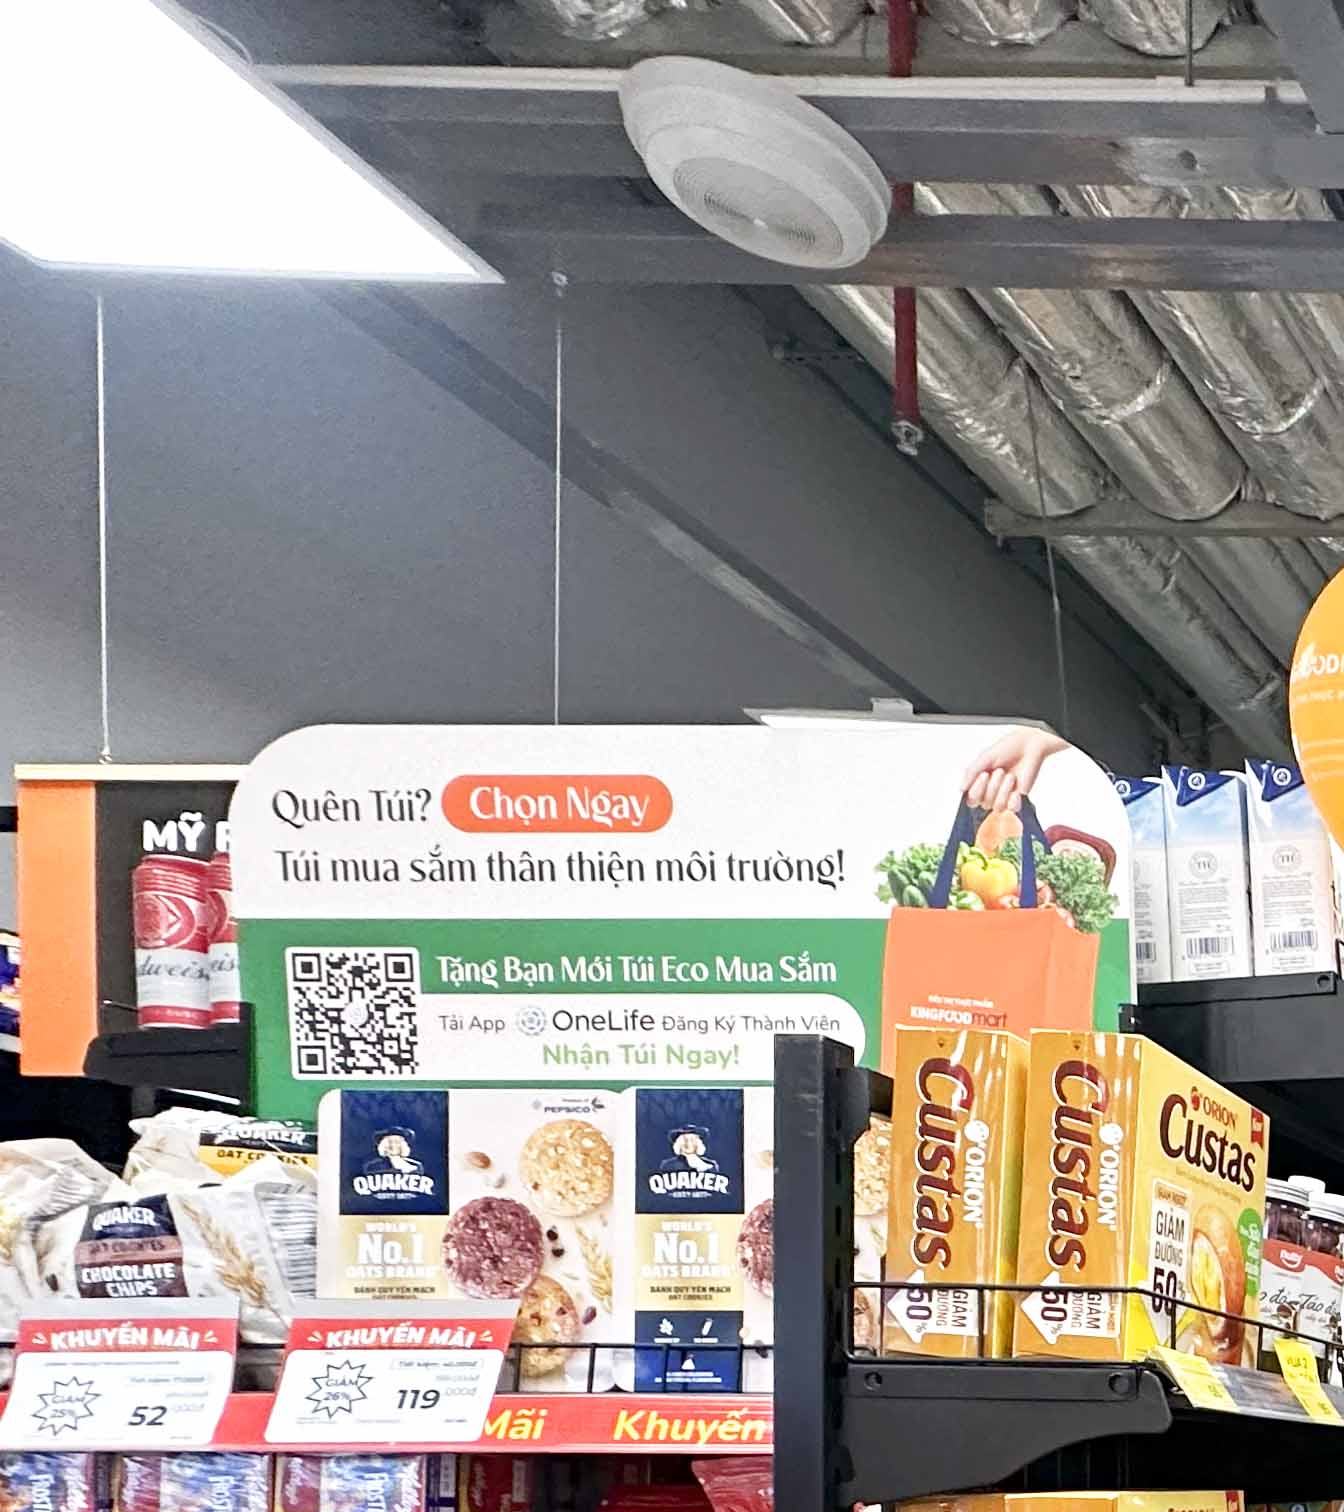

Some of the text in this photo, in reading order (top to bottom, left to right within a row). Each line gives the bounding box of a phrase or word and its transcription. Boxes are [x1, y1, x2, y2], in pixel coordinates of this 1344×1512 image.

[272, 788, 432, 827] Quên Túi?
[470, 786, 651, 829] Chọn Ngay
[143, 811, 204, 852] MỸ
[274, 844, 846, 891] Túi mua sắm thân thiện môi trường!
[437, 950, 837, 989] Tặng Bạn Mới Túi Eco Mua Sắm
[439, 1009, 841, 1036] Tải App OneLife Đăng Ký Thành Viên
[543, 1042, 741, 1072] Nhận Túi Ngay!
[1203, 1097, 1238, 1131] ORION
[1159, 1093, 1257, 1194] Custas
[353, 1173, 434, 1198] QUAKER
[649, 1171, 729, 1196] QUAKER
[963, 1139, 990, 1223] ORION
[1155, 1208, 1186, 1241] GIẢM
[357, 1231, 426, 1266] No.1
[653, 1231, 721, 1266] No.1
[82, 1261, 177, 1284] CHOCOLATE
[106, 1279, 158, 1298] CHIPS
[51, 1322, 200, 1352] KHUYẾN MÃI
[326, 1321, 476, 1349] KHUYẾN MÃI
[128, 1406, 168, 1427] 52
[395, 1389, 441, 1411] 119
[612, 1406, 767, 1448] Khuyến
